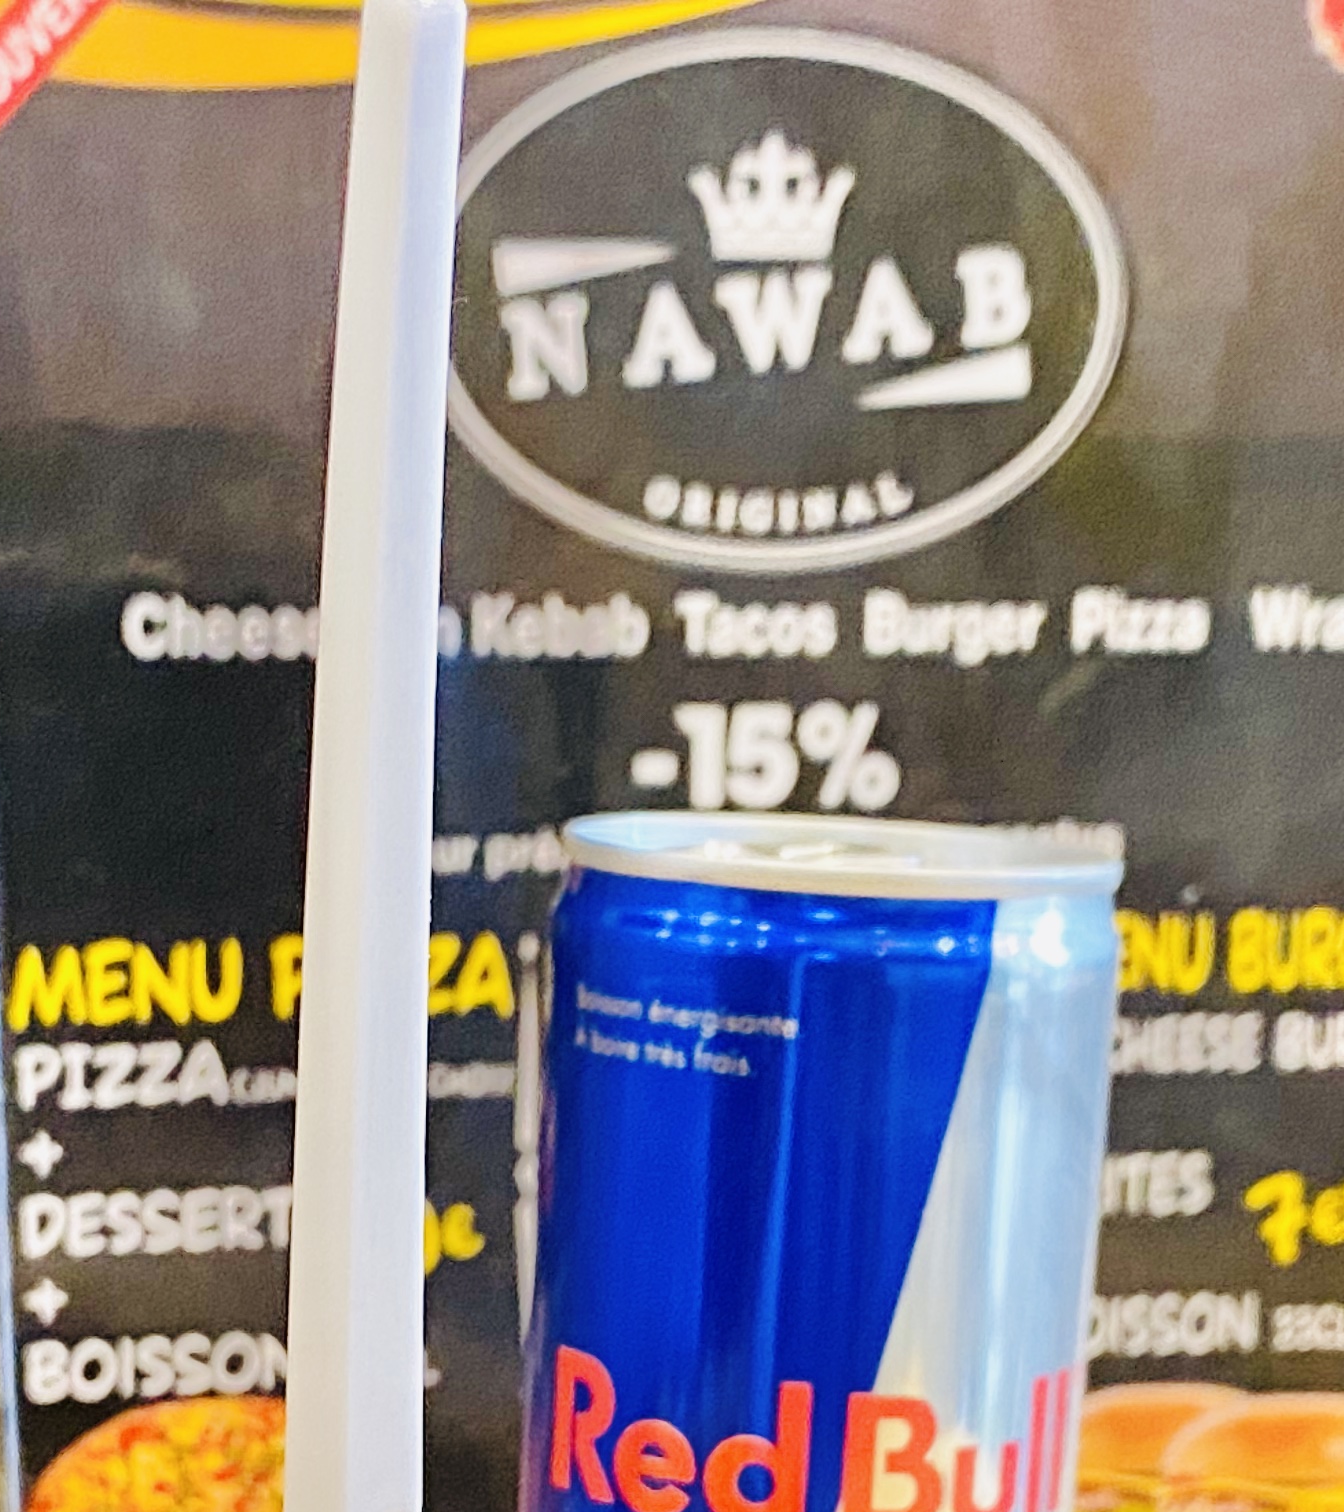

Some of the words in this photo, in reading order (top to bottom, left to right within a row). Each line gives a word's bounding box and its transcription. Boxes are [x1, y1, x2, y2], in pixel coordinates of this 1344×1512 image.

[499, 242, 1032, 401] NAWAB
[642, 468, 915, 536] ORIGINAL
[469, 591, 651, 659] Kebab
[674, 590, 838, 658] Tacos
[862, 588, 1049, 666] Burger
[1070, 586, 1213, 655] Pizza
[630, 698, 902, 812] -15%
[8, 936, 244, 1032] MENU
[269, 930, 515, 1021] PZA
[1114, 908, 1217, 995] NU
[14, 1038, 230, 1112] PIZZA
[1102, 1149, 1215, 1219] ITES
[20, 1185, 293, 1260] DESSERT
[1087, 1289, 1261, 1360] OISSON
[22, 1331, 289, 1404] BOISSON
